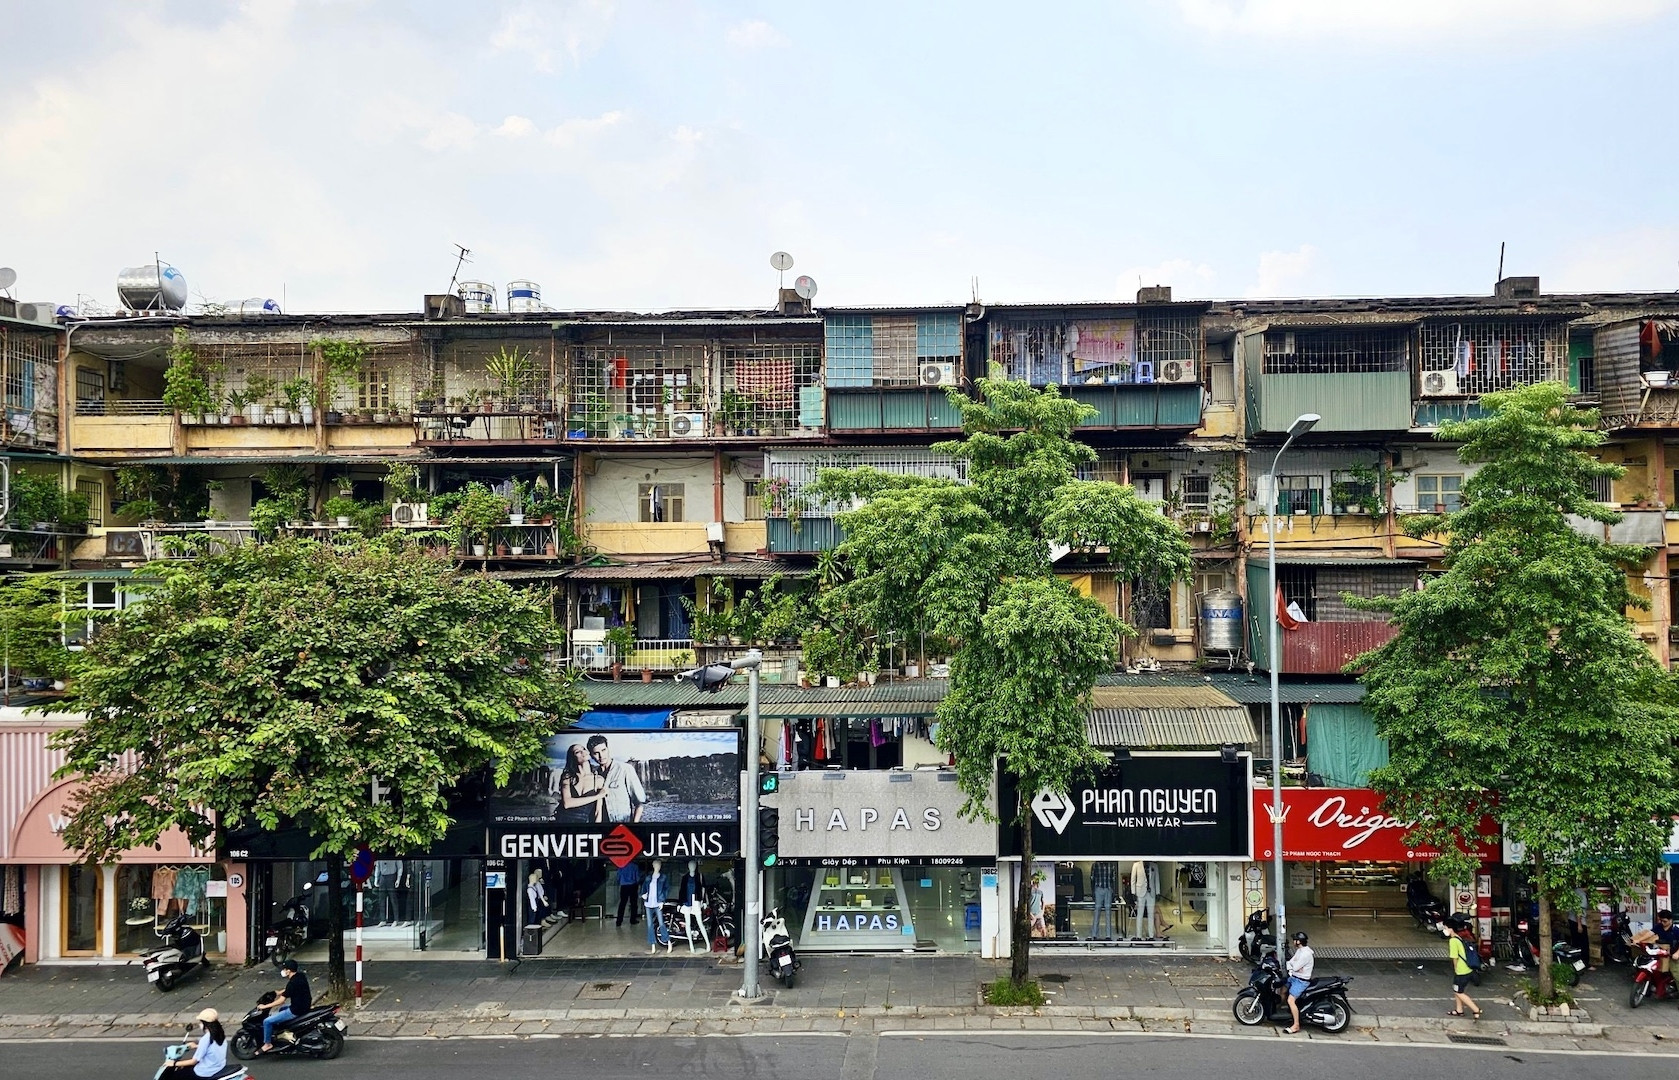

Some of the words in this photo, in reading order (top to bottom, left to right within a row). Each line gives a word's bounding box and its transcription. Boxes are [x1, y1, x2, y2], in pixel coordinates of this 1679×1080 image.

[113, 534, 137, 553] C2
[795, 806, 942, 832] HAPAS
[1117, 817, 1144, 828] MEN
[1146, 816, 1181, 828] WEAR
[501, 834, 603, 858] GENVIET
[643, 832, 723, 857] JEANS
[818, 914, 898, 931] HAPAS
